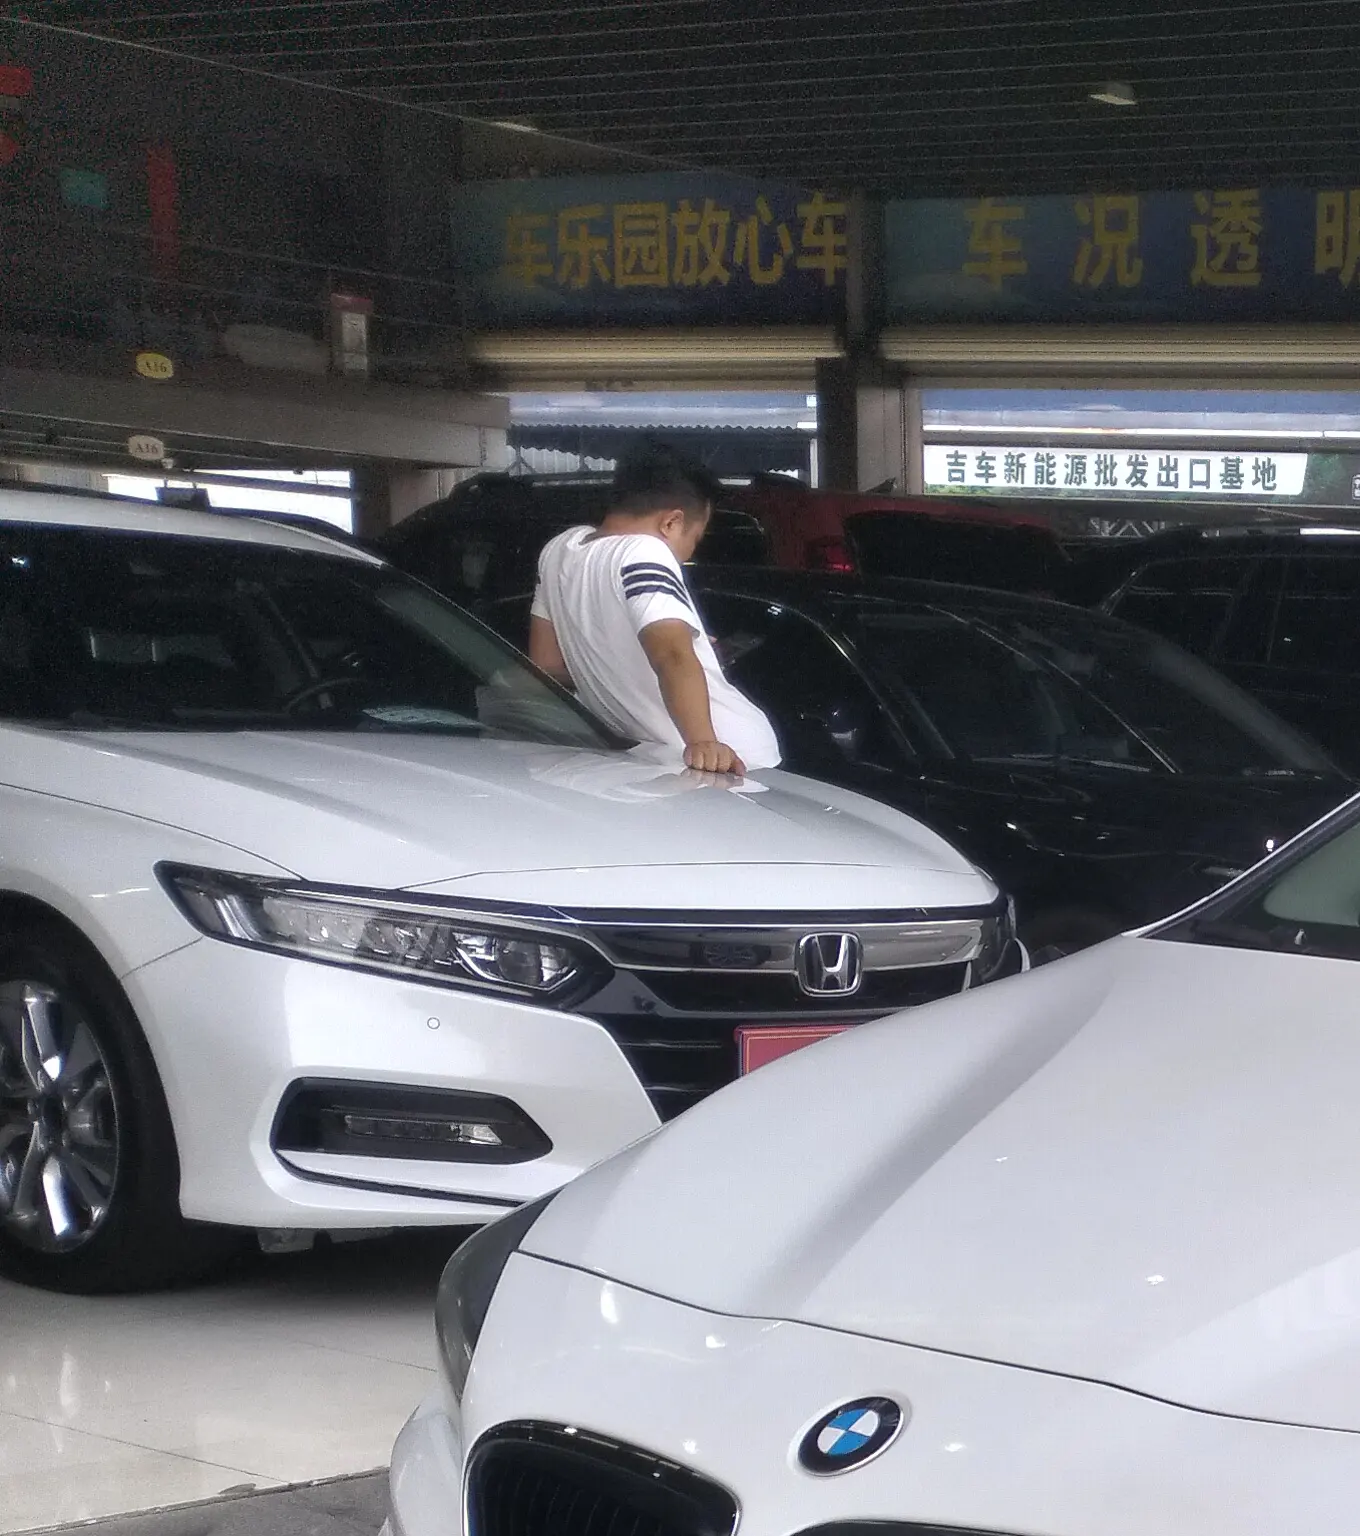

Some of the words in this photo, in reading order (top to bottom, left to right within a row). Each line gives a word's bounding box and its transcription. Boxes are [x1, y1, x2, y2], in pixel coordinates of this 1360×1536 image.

[945, 451, 1278, 491] 吉车新能源批发出口基地
